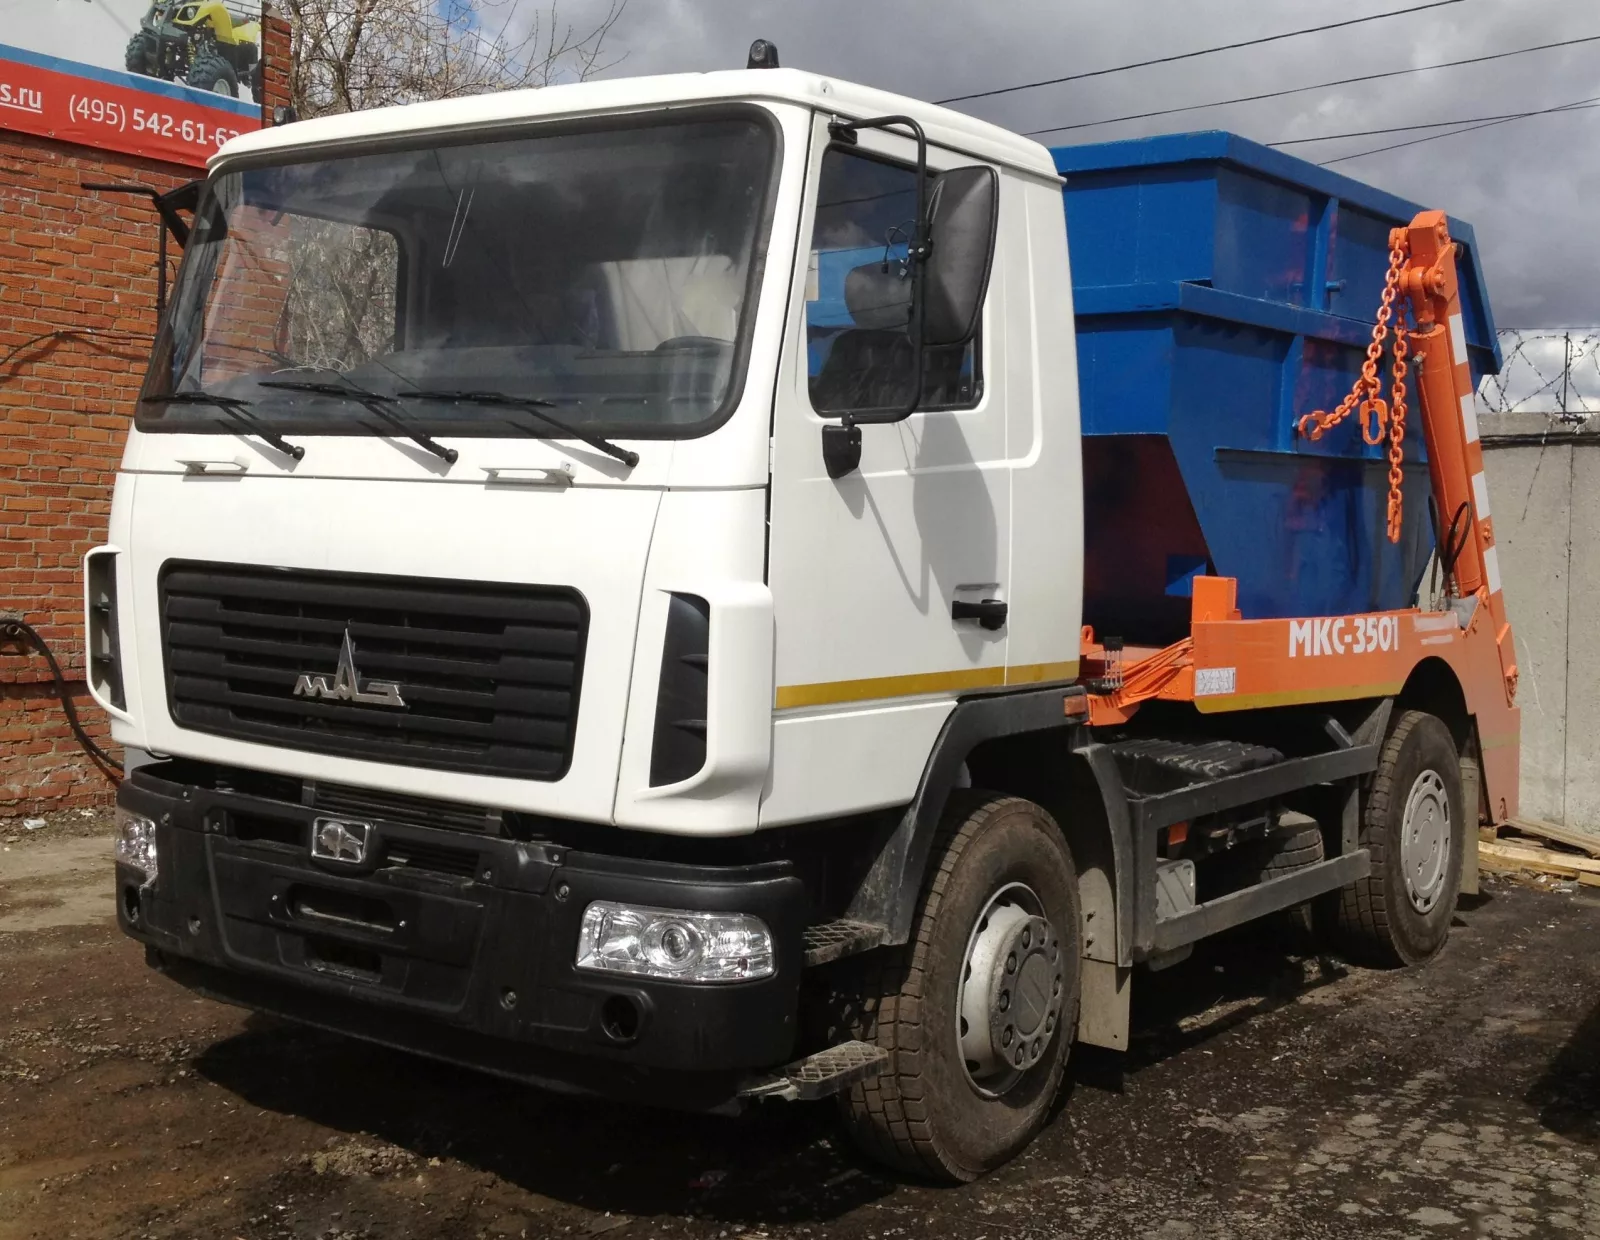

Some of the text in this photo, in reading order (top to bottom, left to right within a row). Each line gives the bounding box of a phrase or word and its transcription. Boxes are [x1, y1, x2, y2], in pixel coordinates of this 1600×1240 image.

[0, 84, 42, 108] s.ru
[69, 94, 126, 132] (495)
[1289, 616, 1398, 657] МКС-3501
